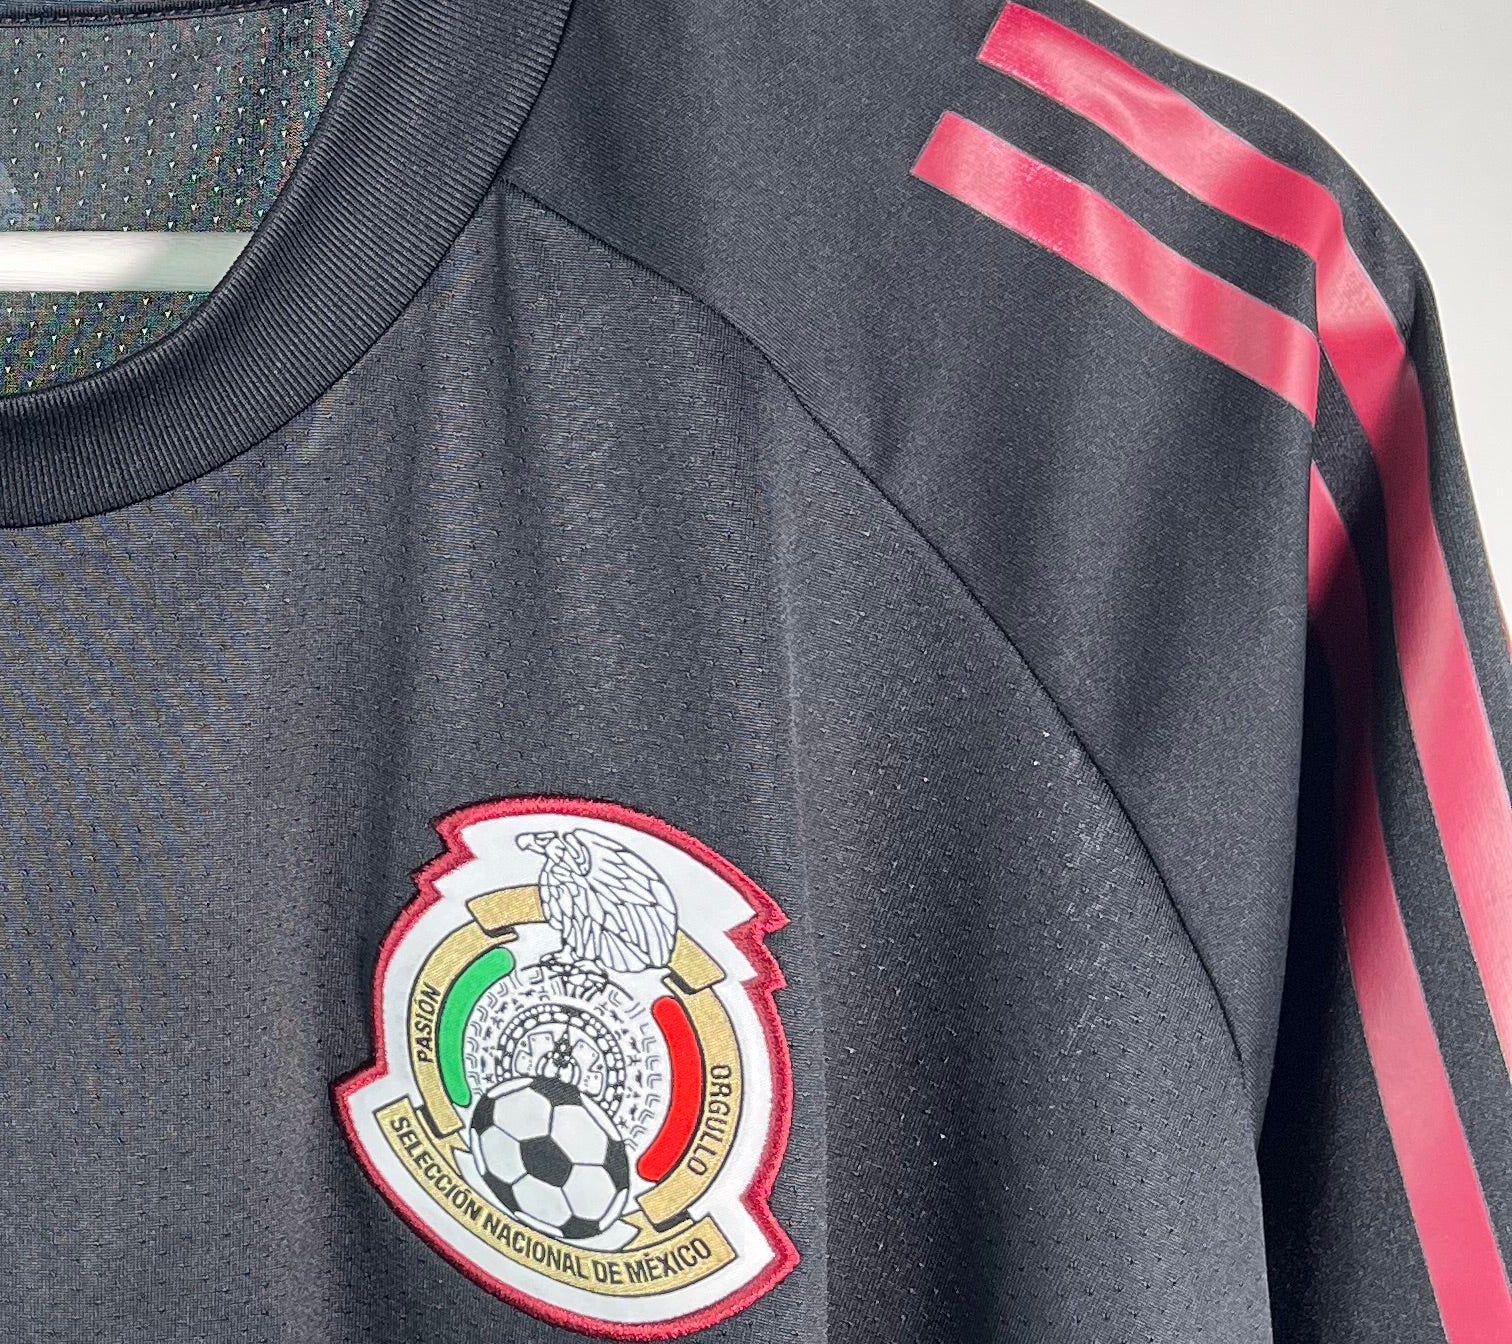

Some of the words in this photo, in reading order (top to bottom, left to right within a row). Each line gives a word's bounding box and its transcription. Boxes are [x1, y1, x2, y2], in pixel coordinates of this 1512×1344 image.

[414, 981, 441, 1064] PASIÓN
[687, 1064, 732, 1176] ORGULLO
[390, 1115, 481, 1221] SELECCIÓN
[482, 1212, 589, 1280] NACIONAL
[594, 1261, 622, 1284] DE
[627, 1236, 713, 1285] MÉXICO
